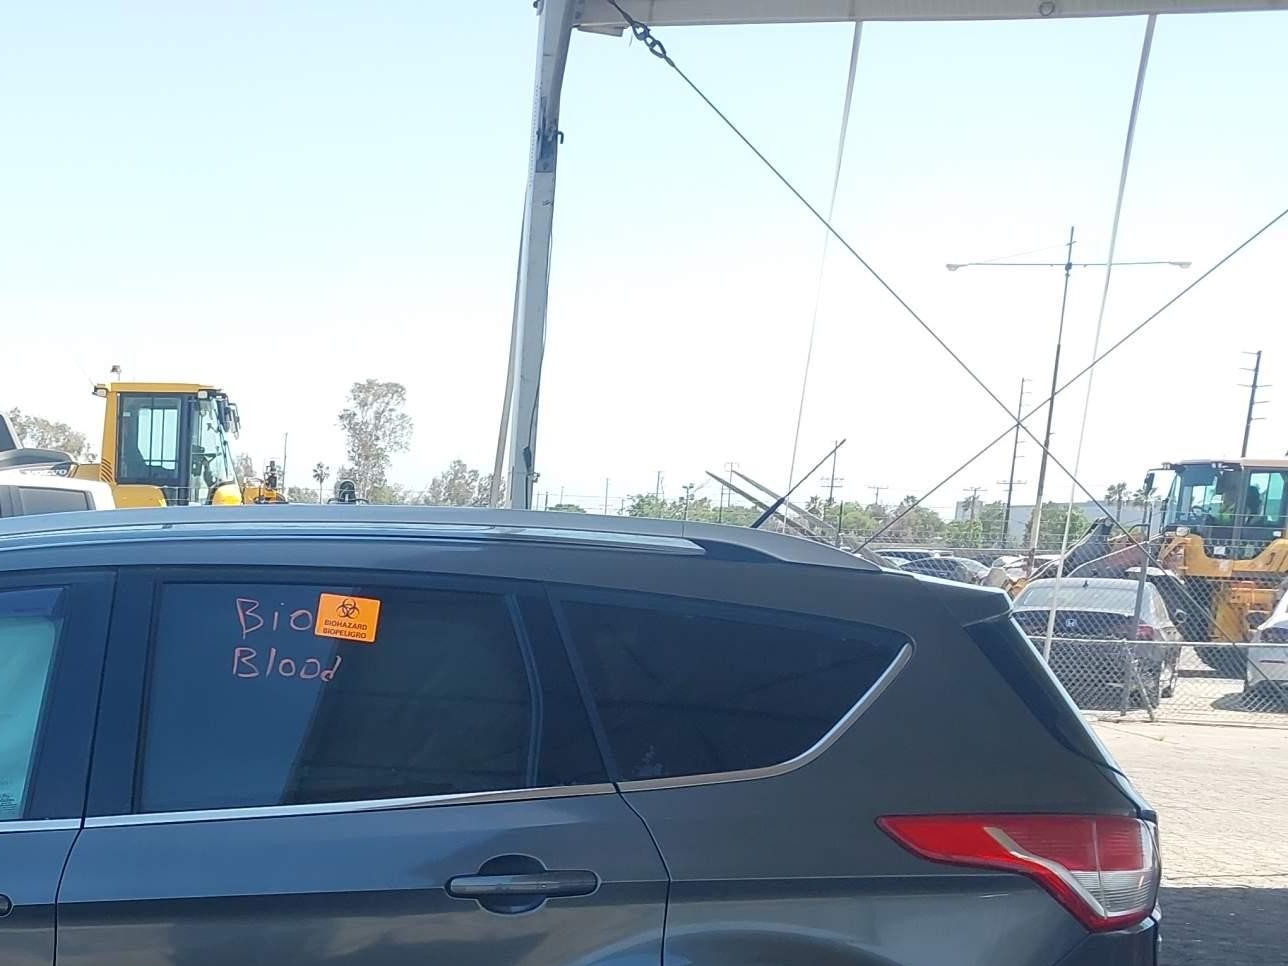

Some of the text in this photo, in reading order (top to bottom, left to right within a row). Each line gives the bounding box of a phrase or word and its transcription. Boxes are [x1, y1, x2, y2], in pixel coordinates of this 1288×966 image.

[236, 598, 313, 640] Bio
[324, 619, 368, 631] BIOHAZARD
[322, 628, 367, 639] BIOPELIGRO
[232, 647, 342, 682] Blood
